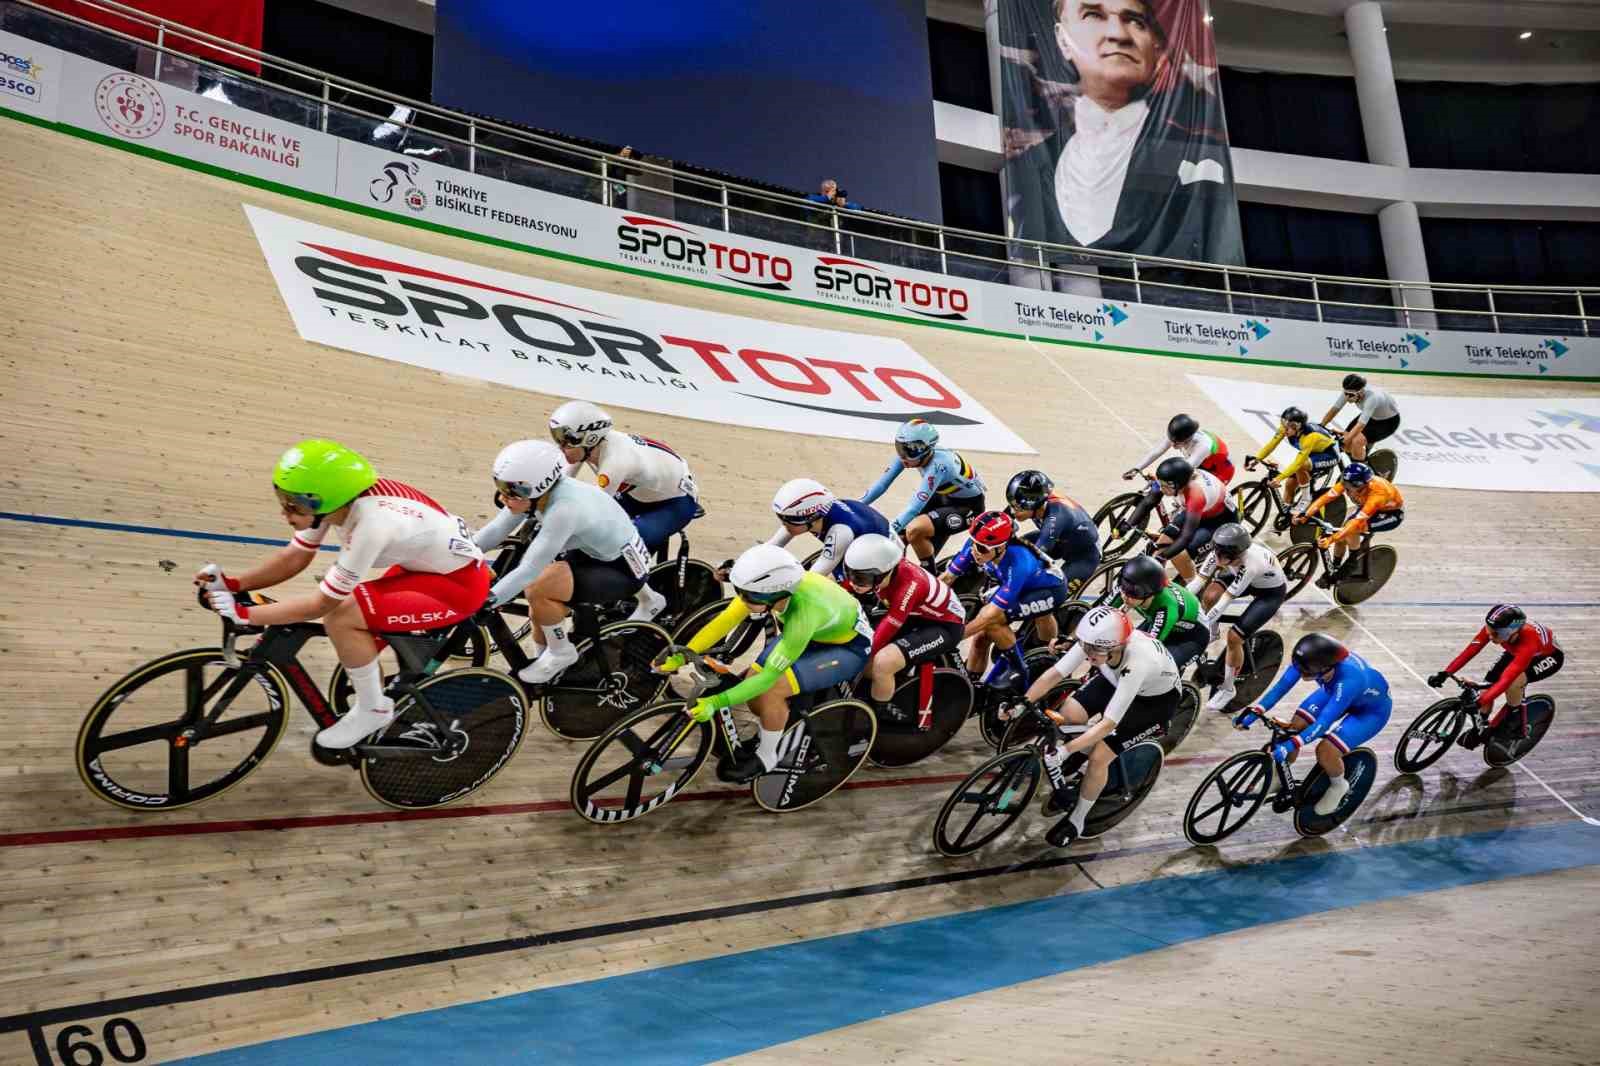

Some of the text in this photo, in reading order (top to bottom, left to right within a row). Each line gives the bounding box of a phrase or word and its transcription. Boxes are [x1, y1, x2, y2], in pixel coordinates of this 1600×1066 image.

[176, 105, 301, 152] T.C. GENÇLİK VE
[174, 123, 300, 168] SPOR BAKANLIĞI
[435, 179, 488, 202] TÜRKİYE
[435, 195, 489, 219] BİSİKLET
[491, 209, 578, 239] FEDERASYONU
[1014, 301, 1105, 326] Türk Telekom
[1164, 320, 1249, 342] Türk Telekom
[1326, 336, 1410, 354] Türk Telekom
[1464, 345, 1548, 360] Türk Telekom
[1395, 425, 1592, 450] elekom
[387, 609, 457, 625] POLSKA
[908, 634, 945, 658] postnord
[1533, 656, 1558, 675] NOR
[56, 1017, 147, 1066] 60
